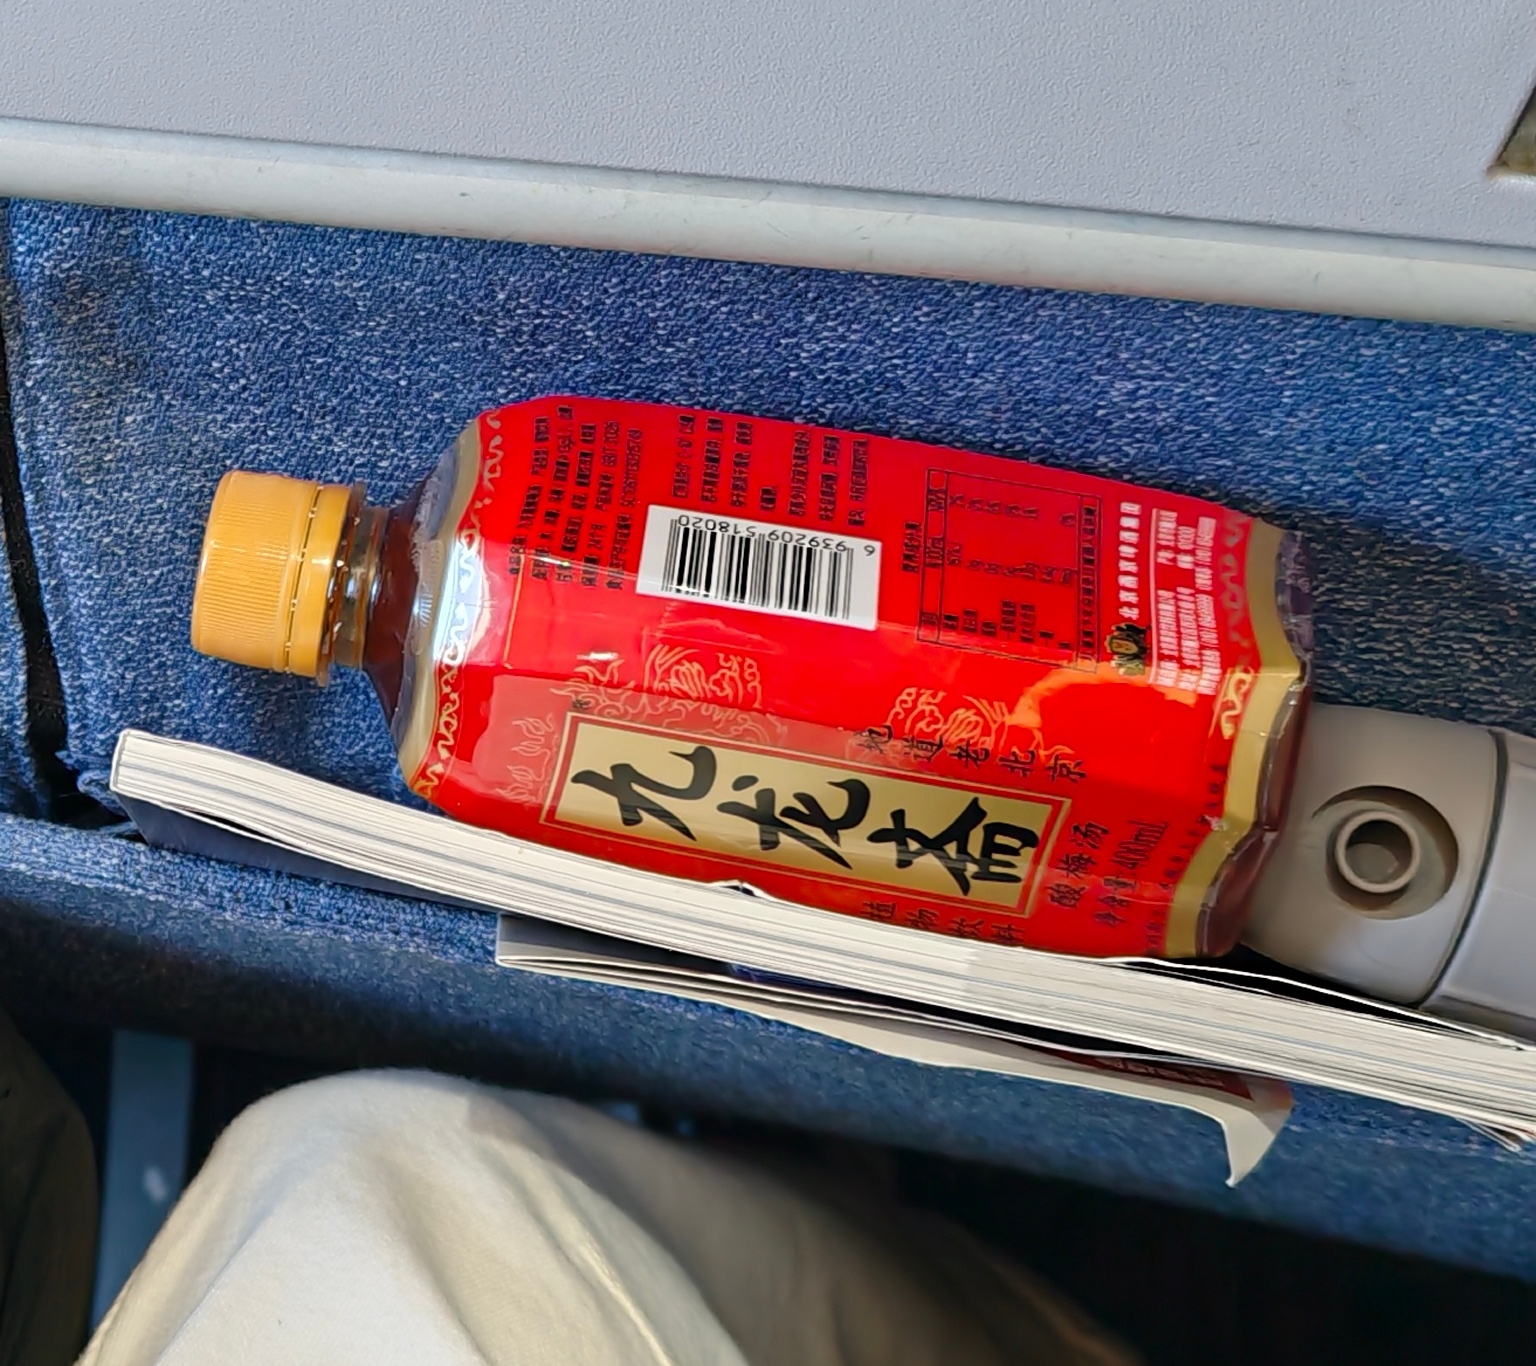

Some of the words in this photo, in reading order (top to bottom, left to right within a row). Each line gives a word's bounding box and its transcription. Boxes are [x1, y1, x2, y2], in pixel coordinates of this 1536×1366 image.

[677, 514, 757, 538] 518020
[767, 529, 848, 553] 939209
[863, 545, 876, 557] 6
[855, 724, 1087, 784] 地道老北京
[571, 744, 1042, 898] 九龙斋
[1047, 819, 1108, 910] 酸梅汤
